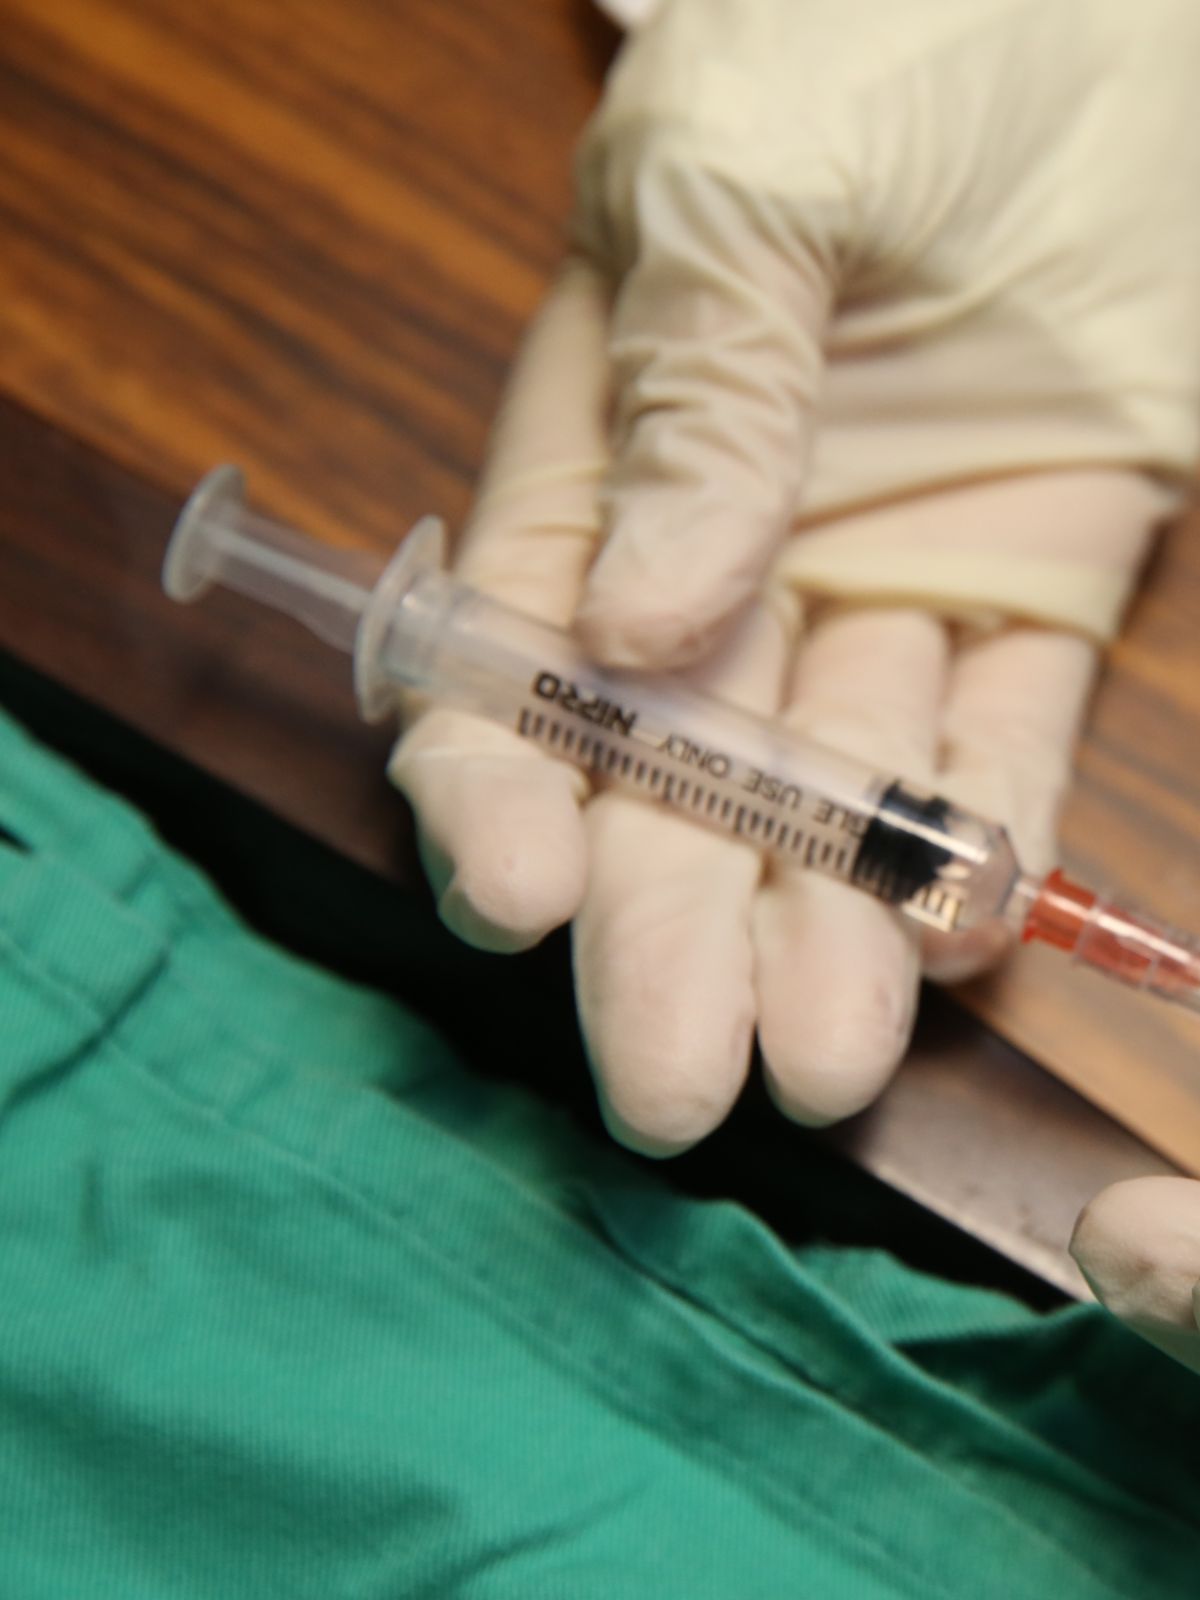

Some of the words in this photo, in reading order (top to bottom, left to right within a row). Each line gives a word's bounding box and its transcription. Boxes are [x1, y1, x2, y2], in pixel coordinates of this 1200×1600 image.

[533, 670, 638, 738] NIPRO
[656, 733, 731, 777] ONLY
[742, 771, 804, 810] USE
